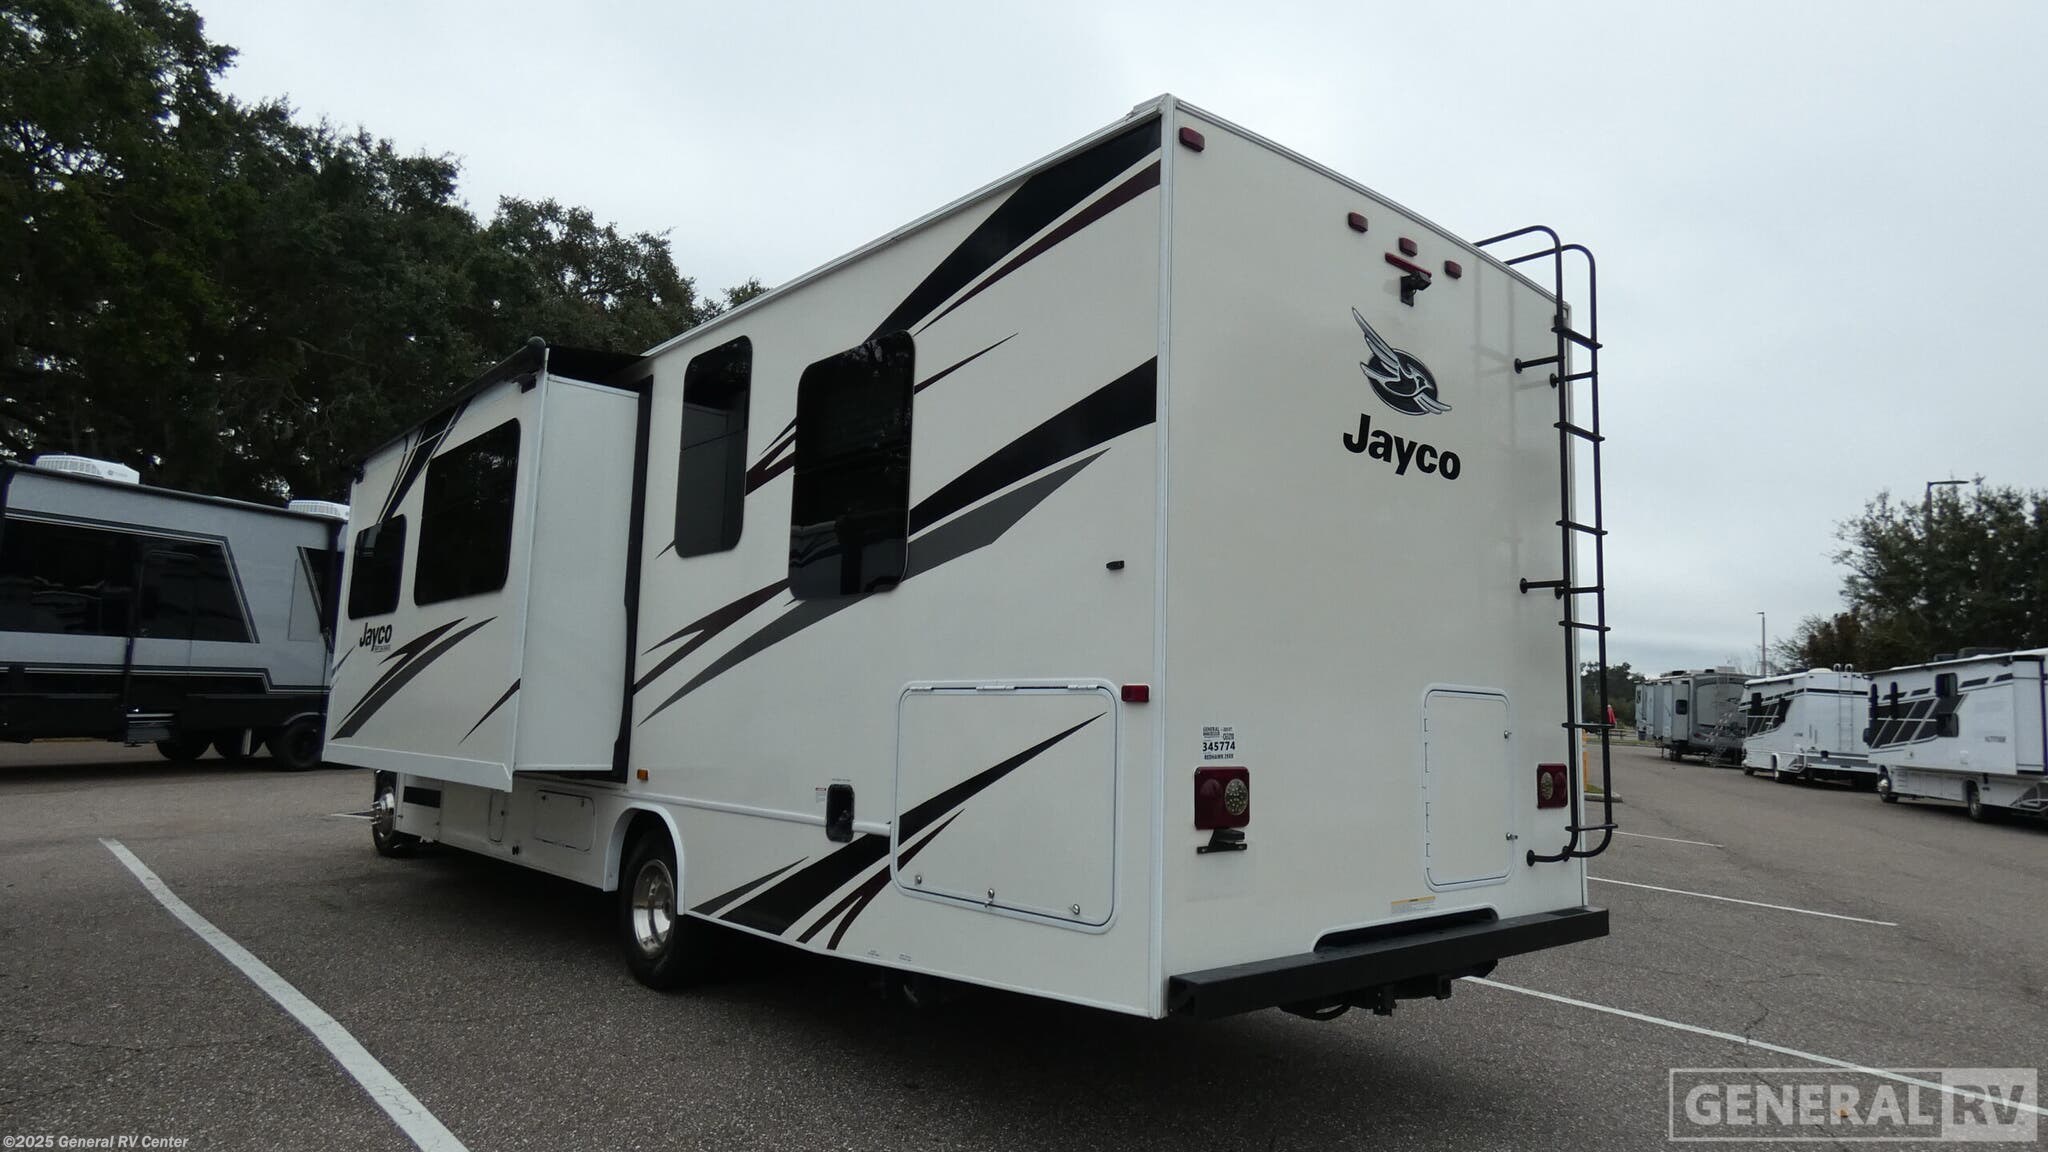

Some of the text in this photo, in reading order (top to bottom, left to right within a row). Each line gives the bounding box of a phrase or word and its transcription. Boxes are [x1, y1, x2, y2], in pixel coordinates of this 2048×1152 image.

[1343, 413, 1461, 480] Jayco
[359, 622, 392, 651] Jayco
[1202, 741, 1235, 751] 345774
